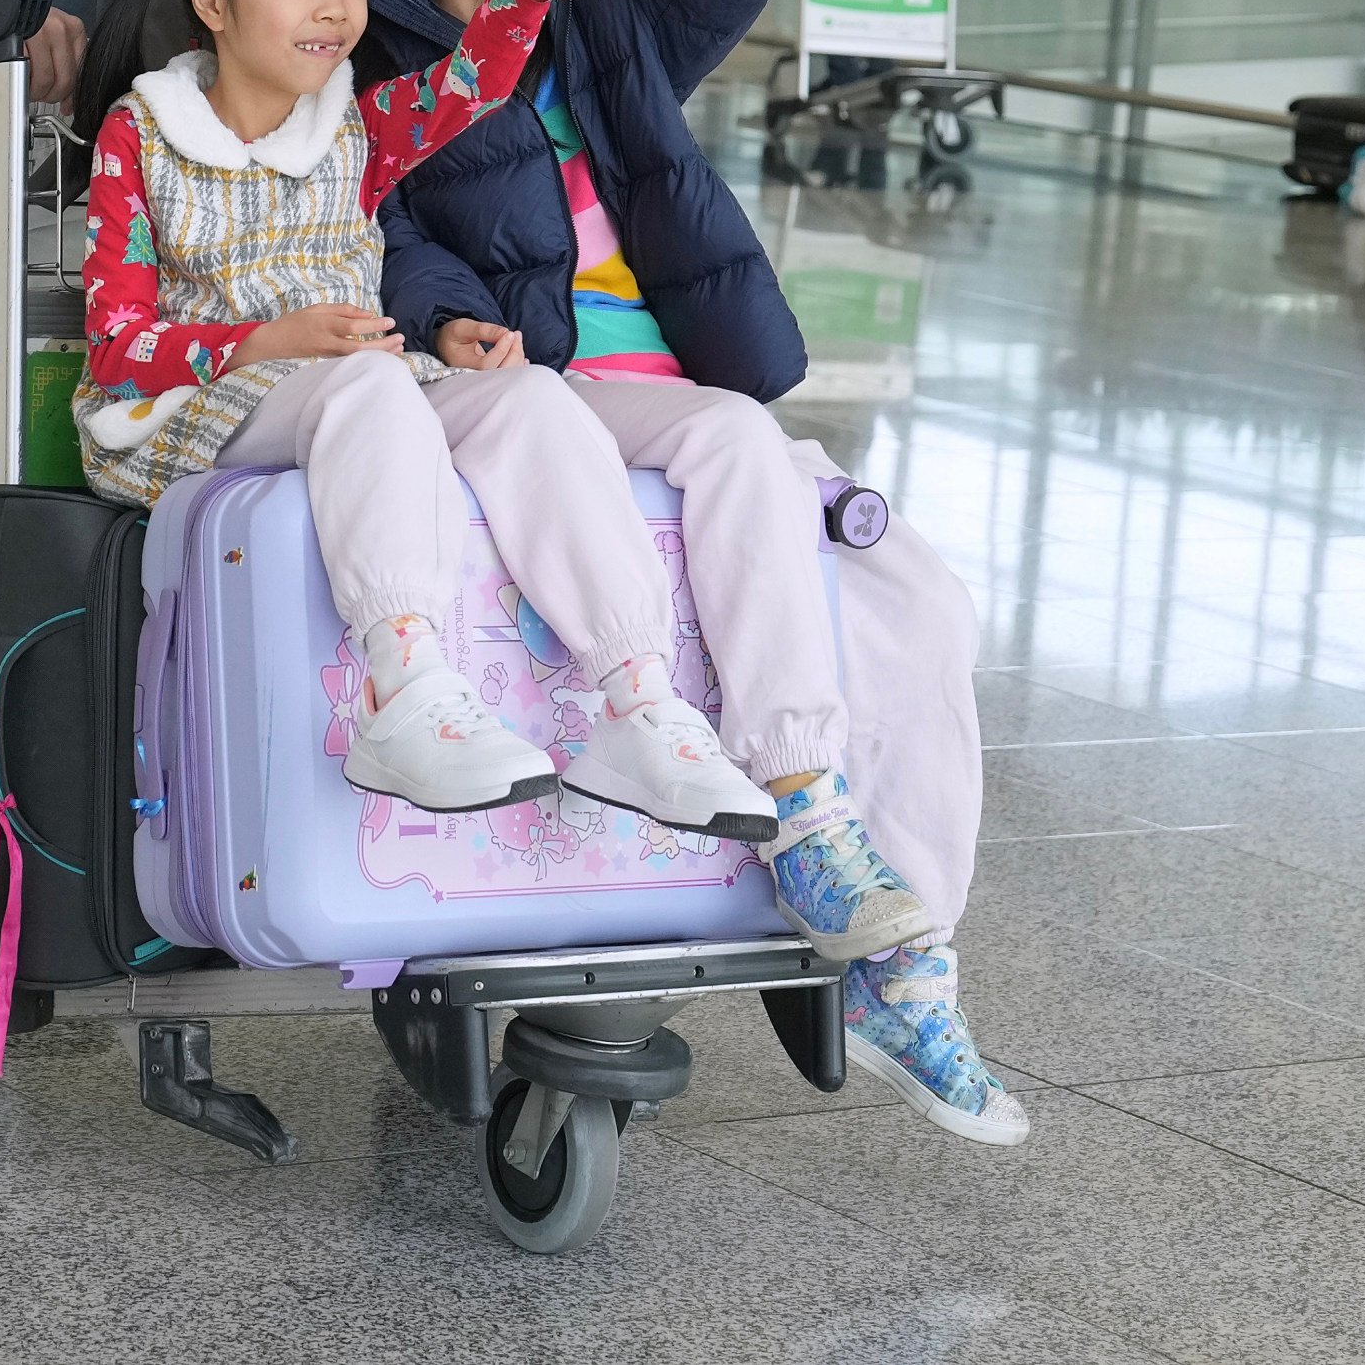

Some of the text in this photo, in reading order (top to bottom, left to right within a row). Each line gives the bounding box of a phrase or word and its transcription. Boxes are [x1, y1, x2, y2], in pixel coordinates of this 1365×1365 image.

[454, 588, 470, 675] rry-go-round...
[445, 816, 460, 840] May
[799, 812, 831, 832] Twinkle
